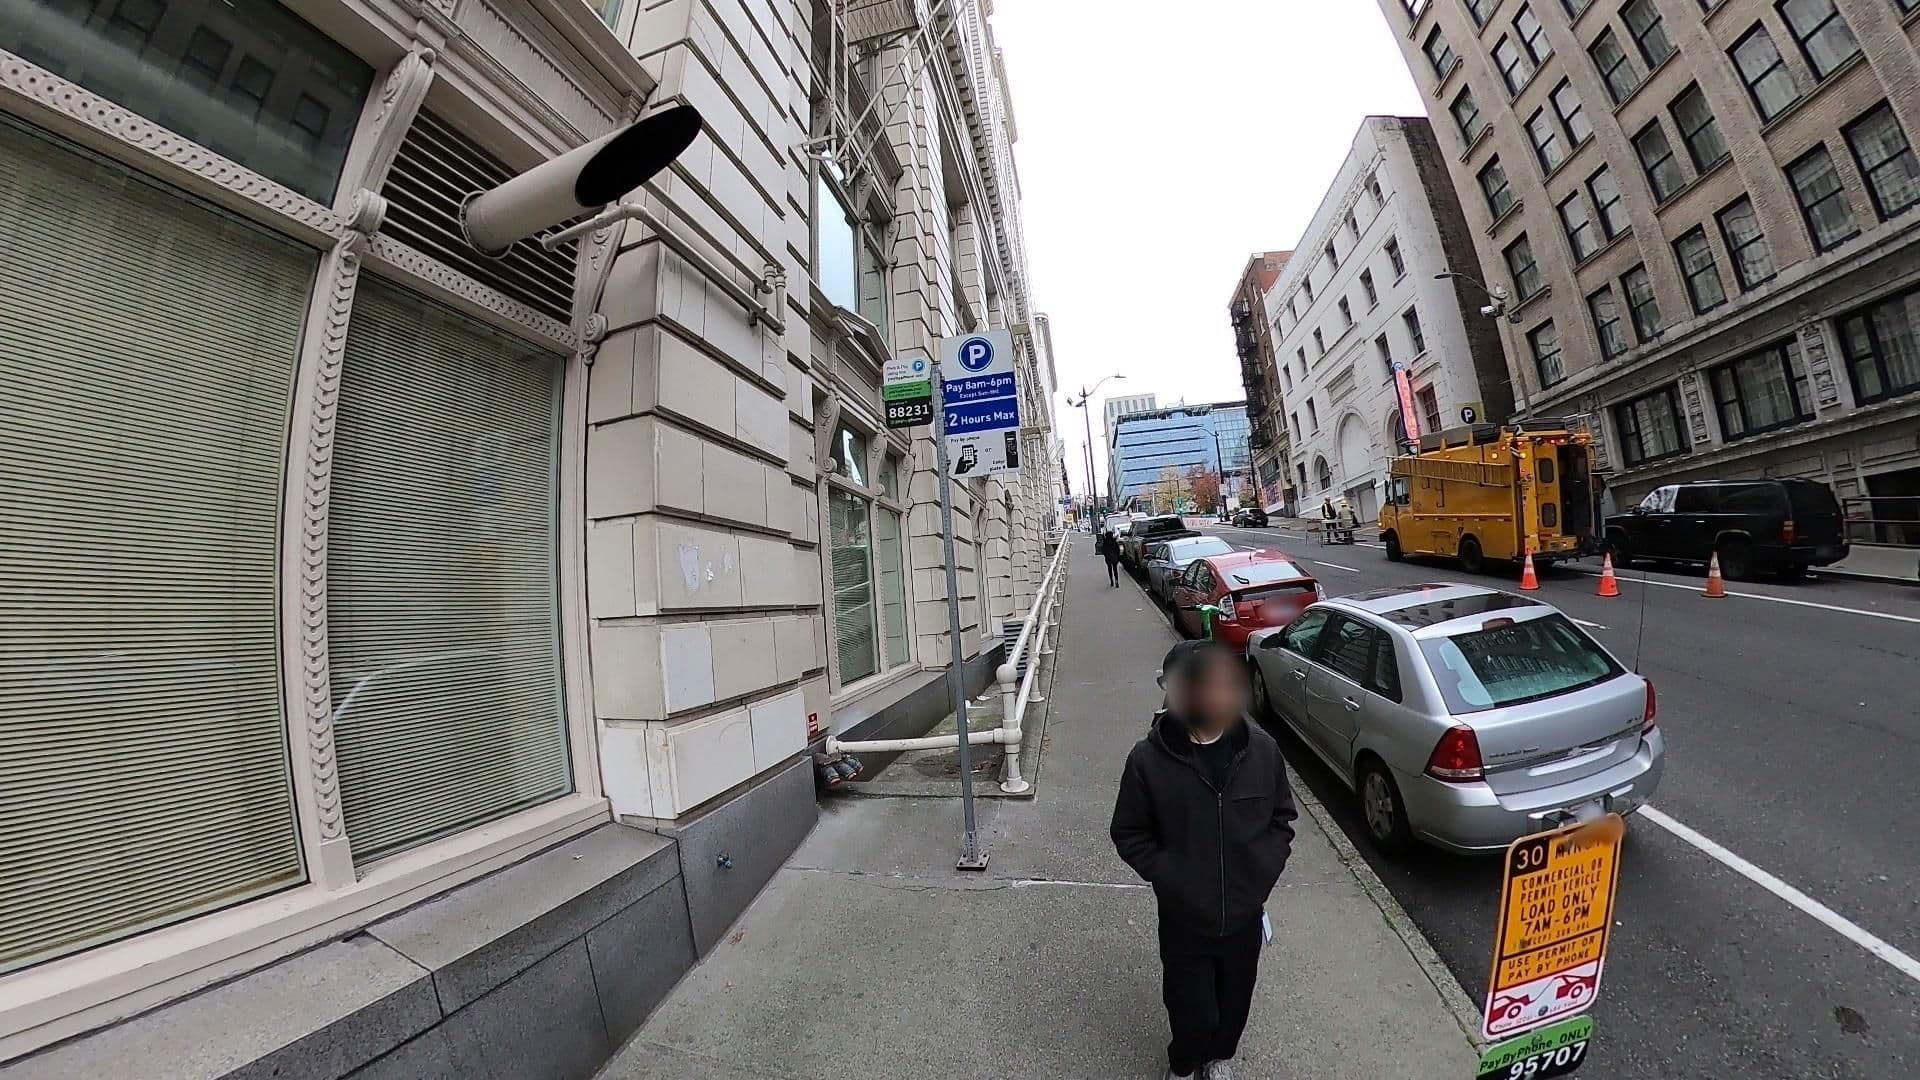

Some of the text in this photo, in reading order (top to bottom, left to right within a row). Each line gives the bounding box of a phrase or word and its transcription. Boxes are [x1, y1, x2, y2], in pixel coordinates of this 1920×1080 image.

[969, 344, 986, 366] P
[946, 377, 1012, 393] Pay 8am-6pm
[889, 404, 929, 418] 88231
[949, 411, 1015, 427] 2 Hours Max
[1464, 409, 1473, 422] P
[1517, 846, 1544, 869] 30
[1520, 870, 1602, 904] PERMIT VEHICLE
[1521, 863, 1584, 891] COMMERCIAL
[1520, 886, 1597, 921] LOAD ONLY
[1508, 935, 1595, 970] USE PERMIT OR
[1508, 950, 1590, 982] PAY BY PHONE
[1560, 1025, 1591, 1044] ONLY
[1510, 1040, 1586, 1080] 95707
